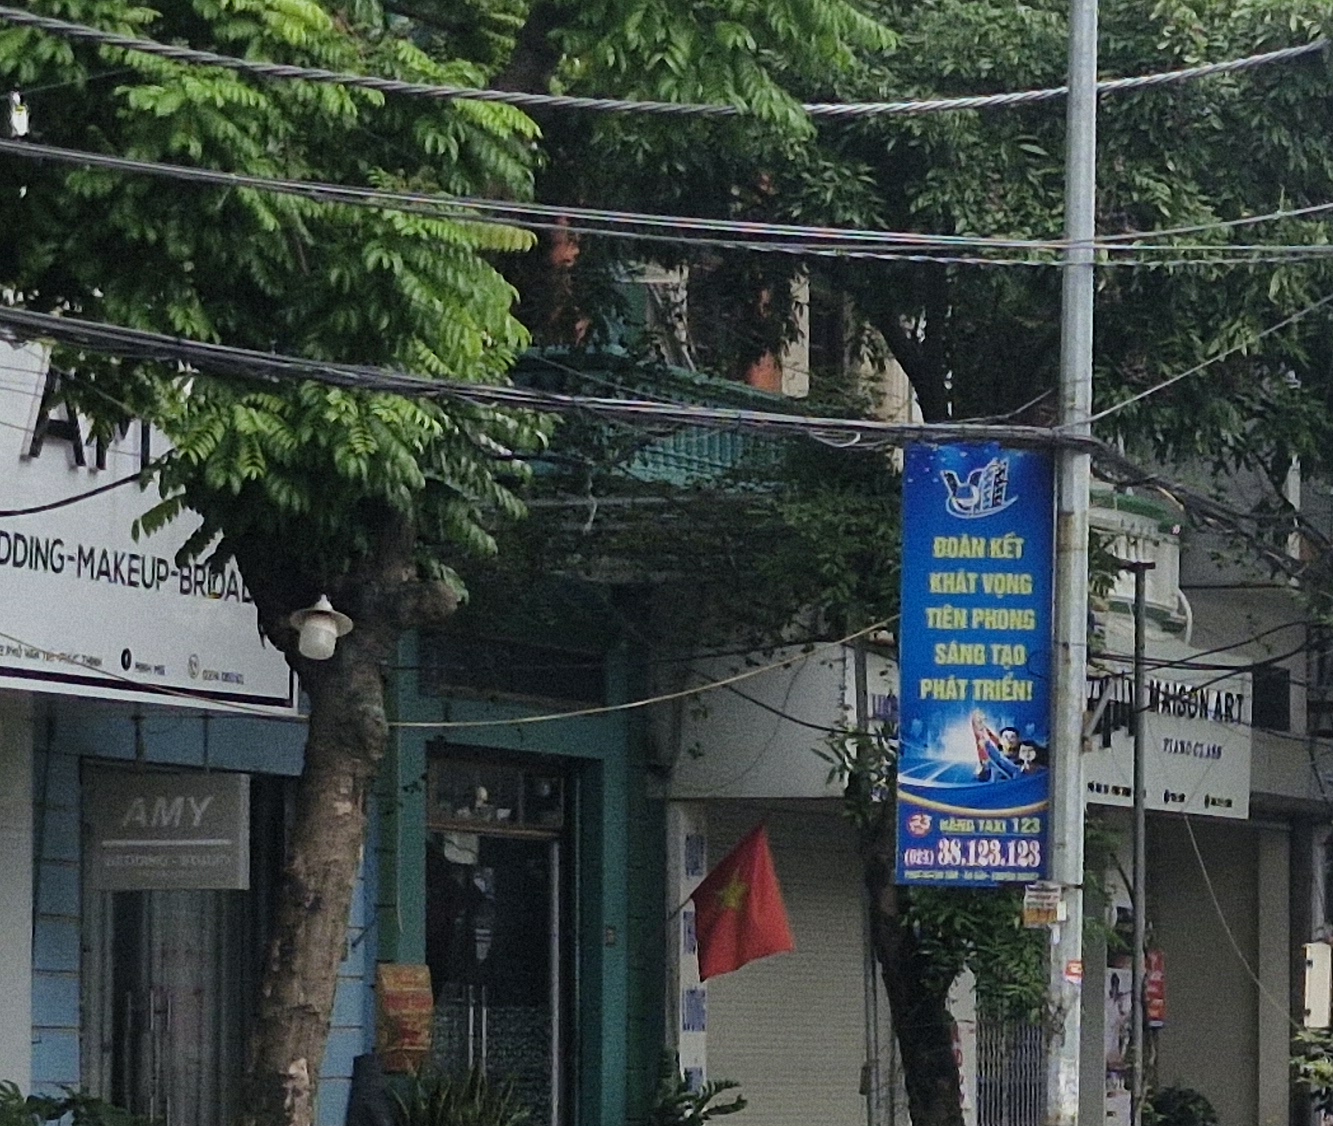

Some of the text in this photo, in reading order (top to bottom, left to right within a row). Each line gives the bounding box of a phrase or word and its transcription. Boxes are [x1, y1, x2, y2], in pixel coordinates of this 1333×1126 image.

[990, 531, 1025, 560] KẾT
[929, 568, 1033, 599] KHÁT VỌNG
[926, 603, 1036, 631] TIÊN PHONG
[934, 640, 1027, 671] SÁNG TẠO
[919, 674, 969, 700] PHÁT
[1213, 690, 1245, 725] ART
[123, 796, 214, 828] AMY
[938, 838, 1042, 868] 38.123.123
